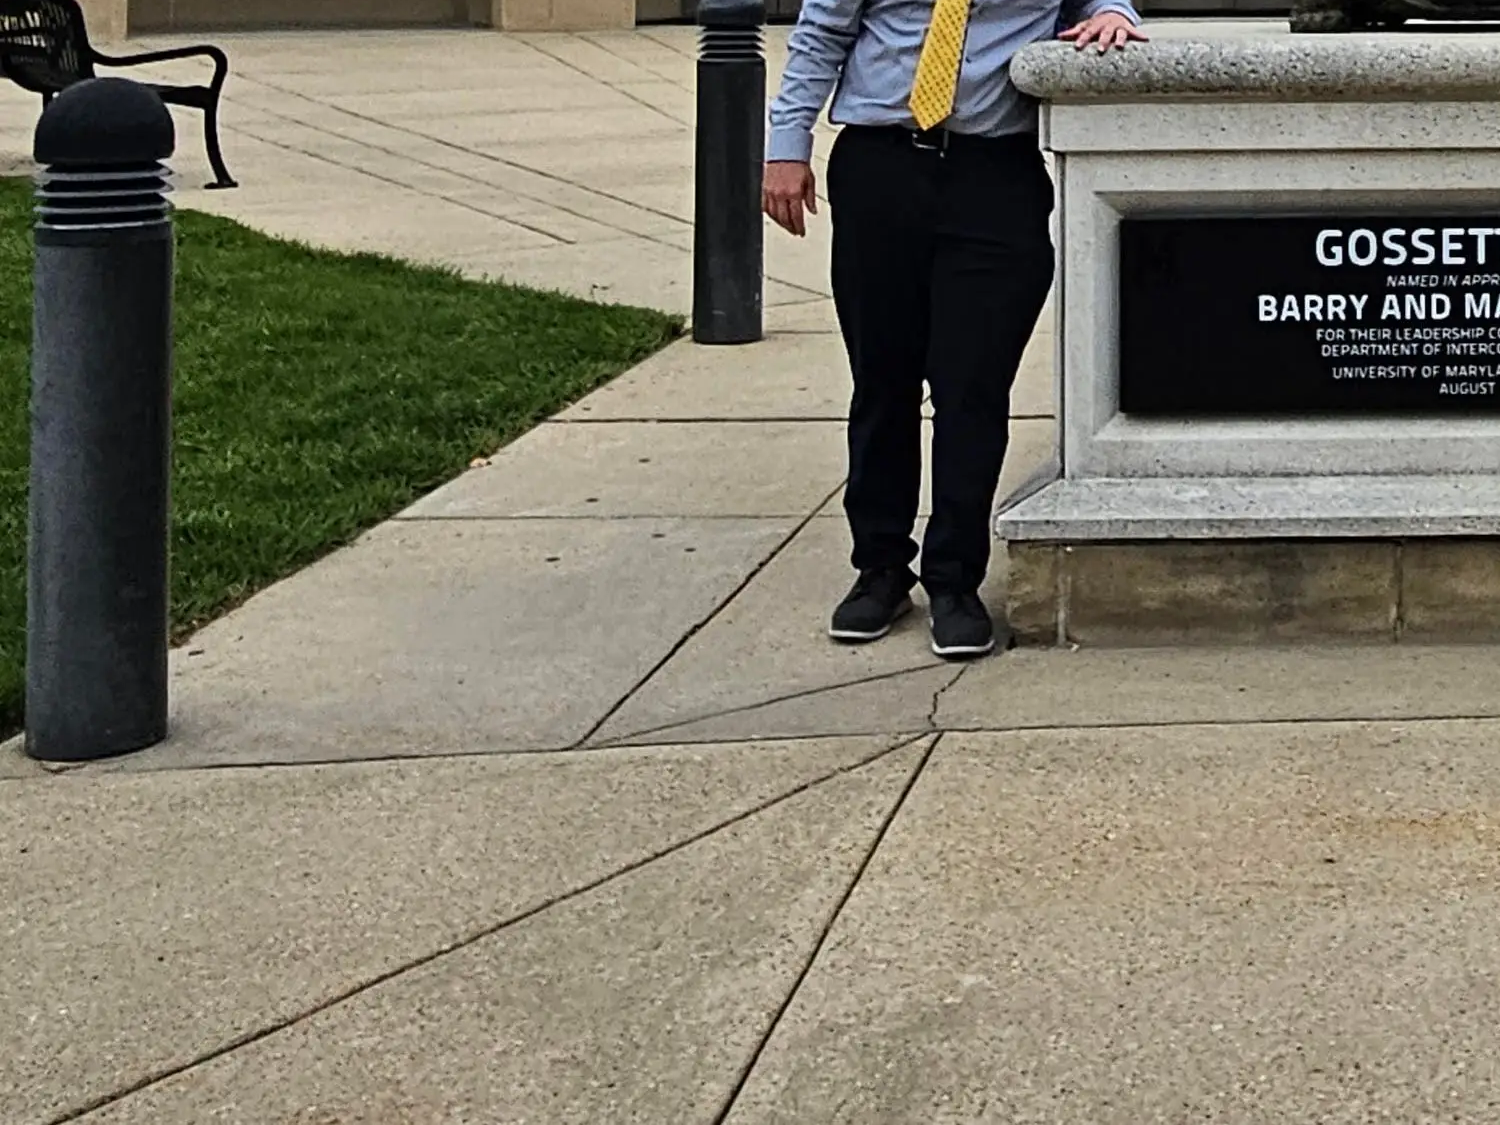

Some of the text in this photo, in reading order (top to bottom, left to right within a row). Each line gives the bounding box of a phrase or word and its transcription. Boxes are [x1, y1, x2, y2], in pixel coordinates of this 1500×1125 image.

[1386, 274, 1440, 288] NAMED
[1443, 274, 1458, 287] IN
[1258, 294, 1369, 322] BARRY
[1380, 292, 1452, 320] AND
[1316, 328, 1346, 341] FOR
[1349, 328, 1392, 341] THEIR
[1396, 326, 1485, 341] LEADERSHIP
[1321, 342, 1419, 357] DEPARTMENT
[1422, 342, 1442, 356] OF
[1332, 365, 1417, 379] UNIVERSITY
[1421, 365, 1441, 378] OF
[1439, 381, 1496, 395] AUGUST
